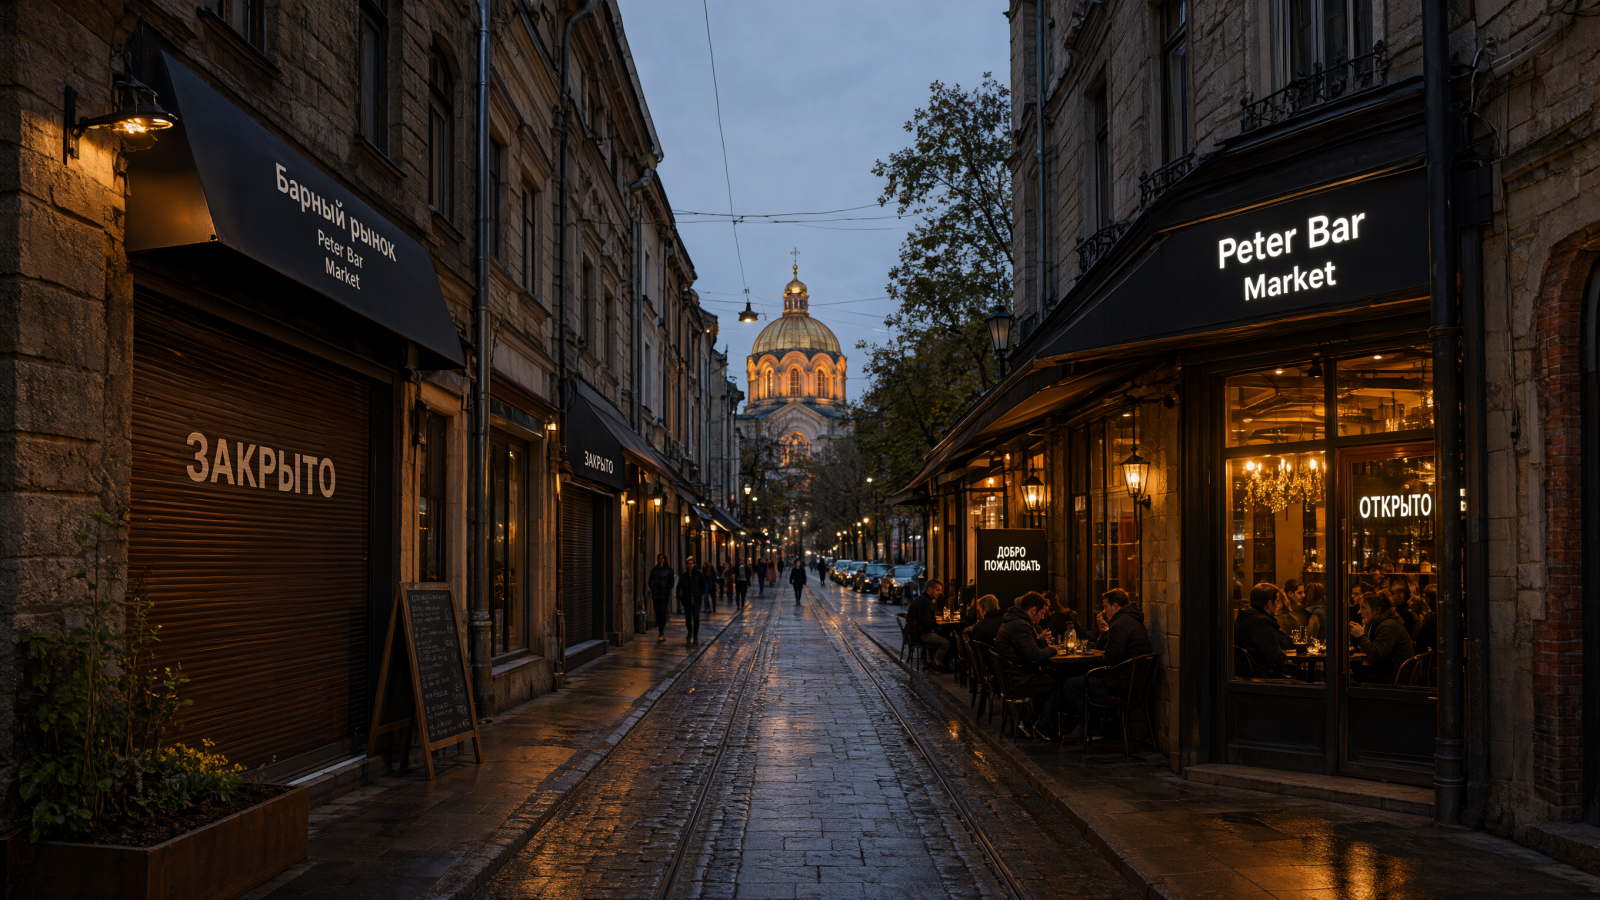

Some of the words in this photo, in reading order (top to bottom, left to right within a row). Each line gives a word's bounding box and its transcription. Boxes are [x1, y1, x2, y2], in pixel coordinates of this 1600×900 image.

[275, 162, 346, 230] Барный
[349, 216, 397, 262] рынок
[317, 229, 344, 258] Peter
[347, 246, 363, 269] Bar
[1218, 228, 1297, 269] Peter
[1308, 212, 1366, 249] Bar
[325, 257, 361, 290] Market
[1244, 261, 1337, 301] Market
[186, 431, 336, 498] ЗАКРЫТО
[584, 450, 614, 475] ЗАКРЫТО
[1359, 493, 1432, 519] ОТКРЫТО
[984, 559, 1041, 571] ПОЖАЛОВАТЬ
[997, 546, 1027, 559] ДОБРО
